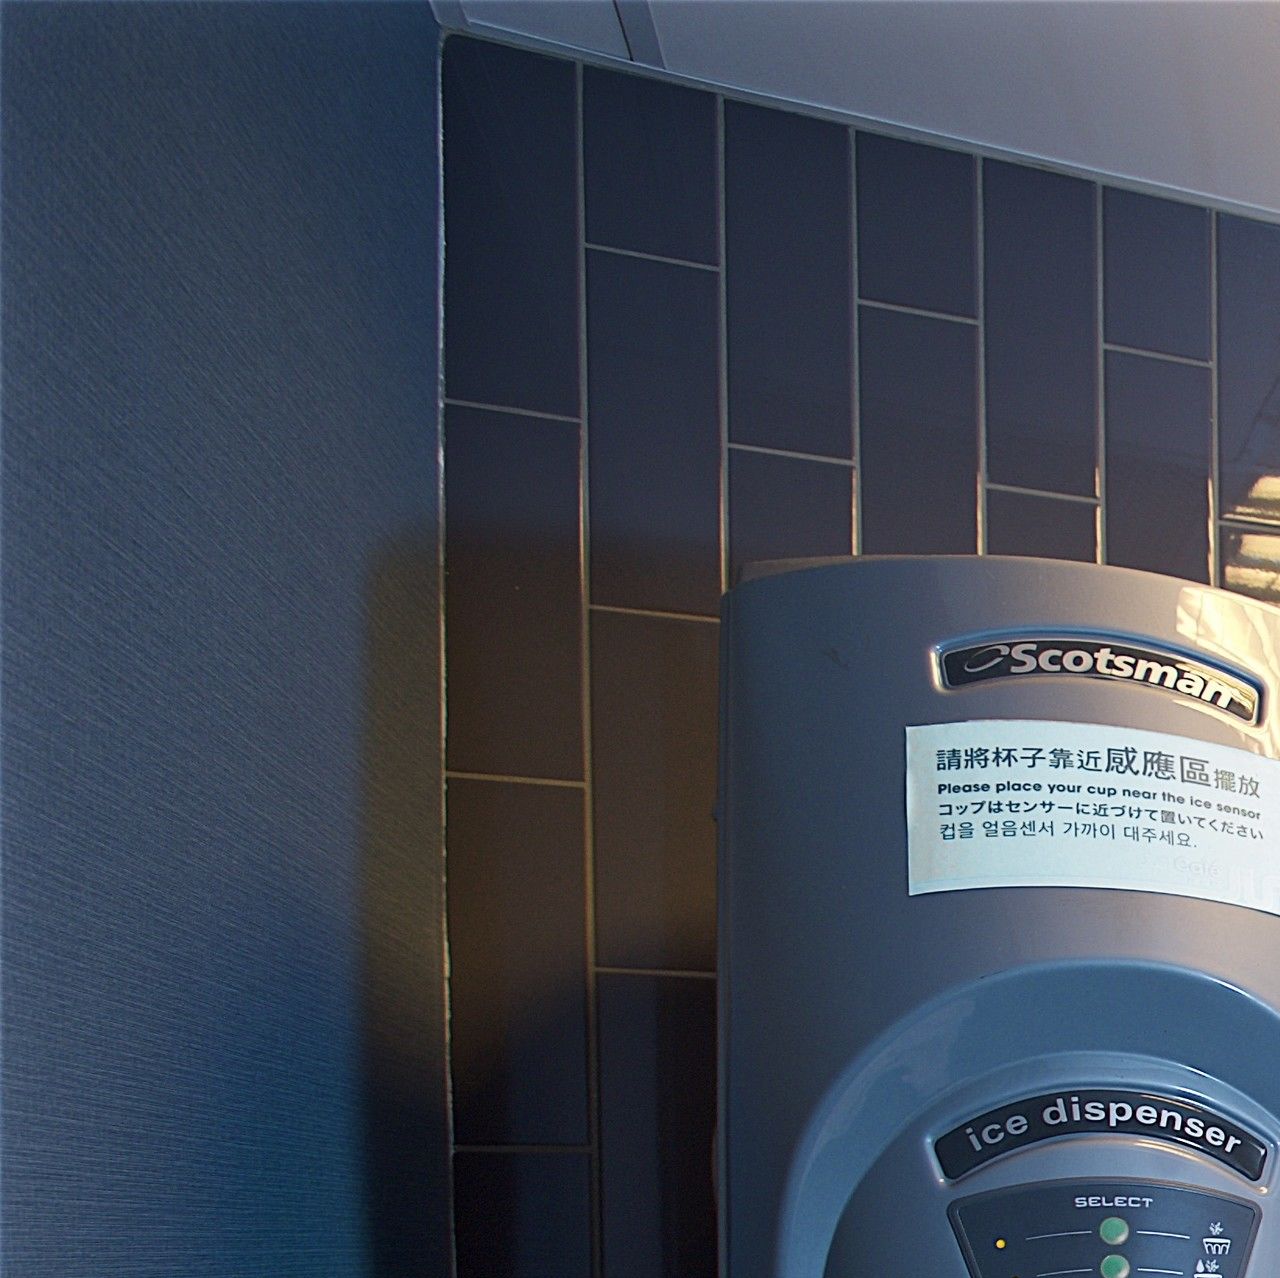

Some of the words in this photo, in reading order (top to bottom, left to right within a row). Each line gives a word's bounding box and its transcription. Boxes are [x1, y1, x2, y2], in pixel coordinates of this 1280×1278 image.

[1010, 643, 1236, 708] Scotsman
[936, 745, 1261, 799] 請將杯子靠近感應區擺放
[937, 782, 991, 796] Please
[995, 780, 1042, 796] place
[1047, 783, 1082, 797] your
[1087, 785, 1118, 799] cup
[1122, 787, 1158, 801] near
[1162, 791, 1186, 805] the
[1190, 795, 1212, 809] ice
[1216, 801, 1261, 820] sensor
[939, 822, 975, 841] 컵을
[982, 820, 1055, 839] 얼음센서
[1062, 822, 1117, 841] 가까이
[1123, 826, 1198, 849] 대주세요.
[964, 1113, 1028, 1152] ice
[1042, 1095, 1243, 1155] dispenser
[1074, 1196, 1153, 1209] SELECT
